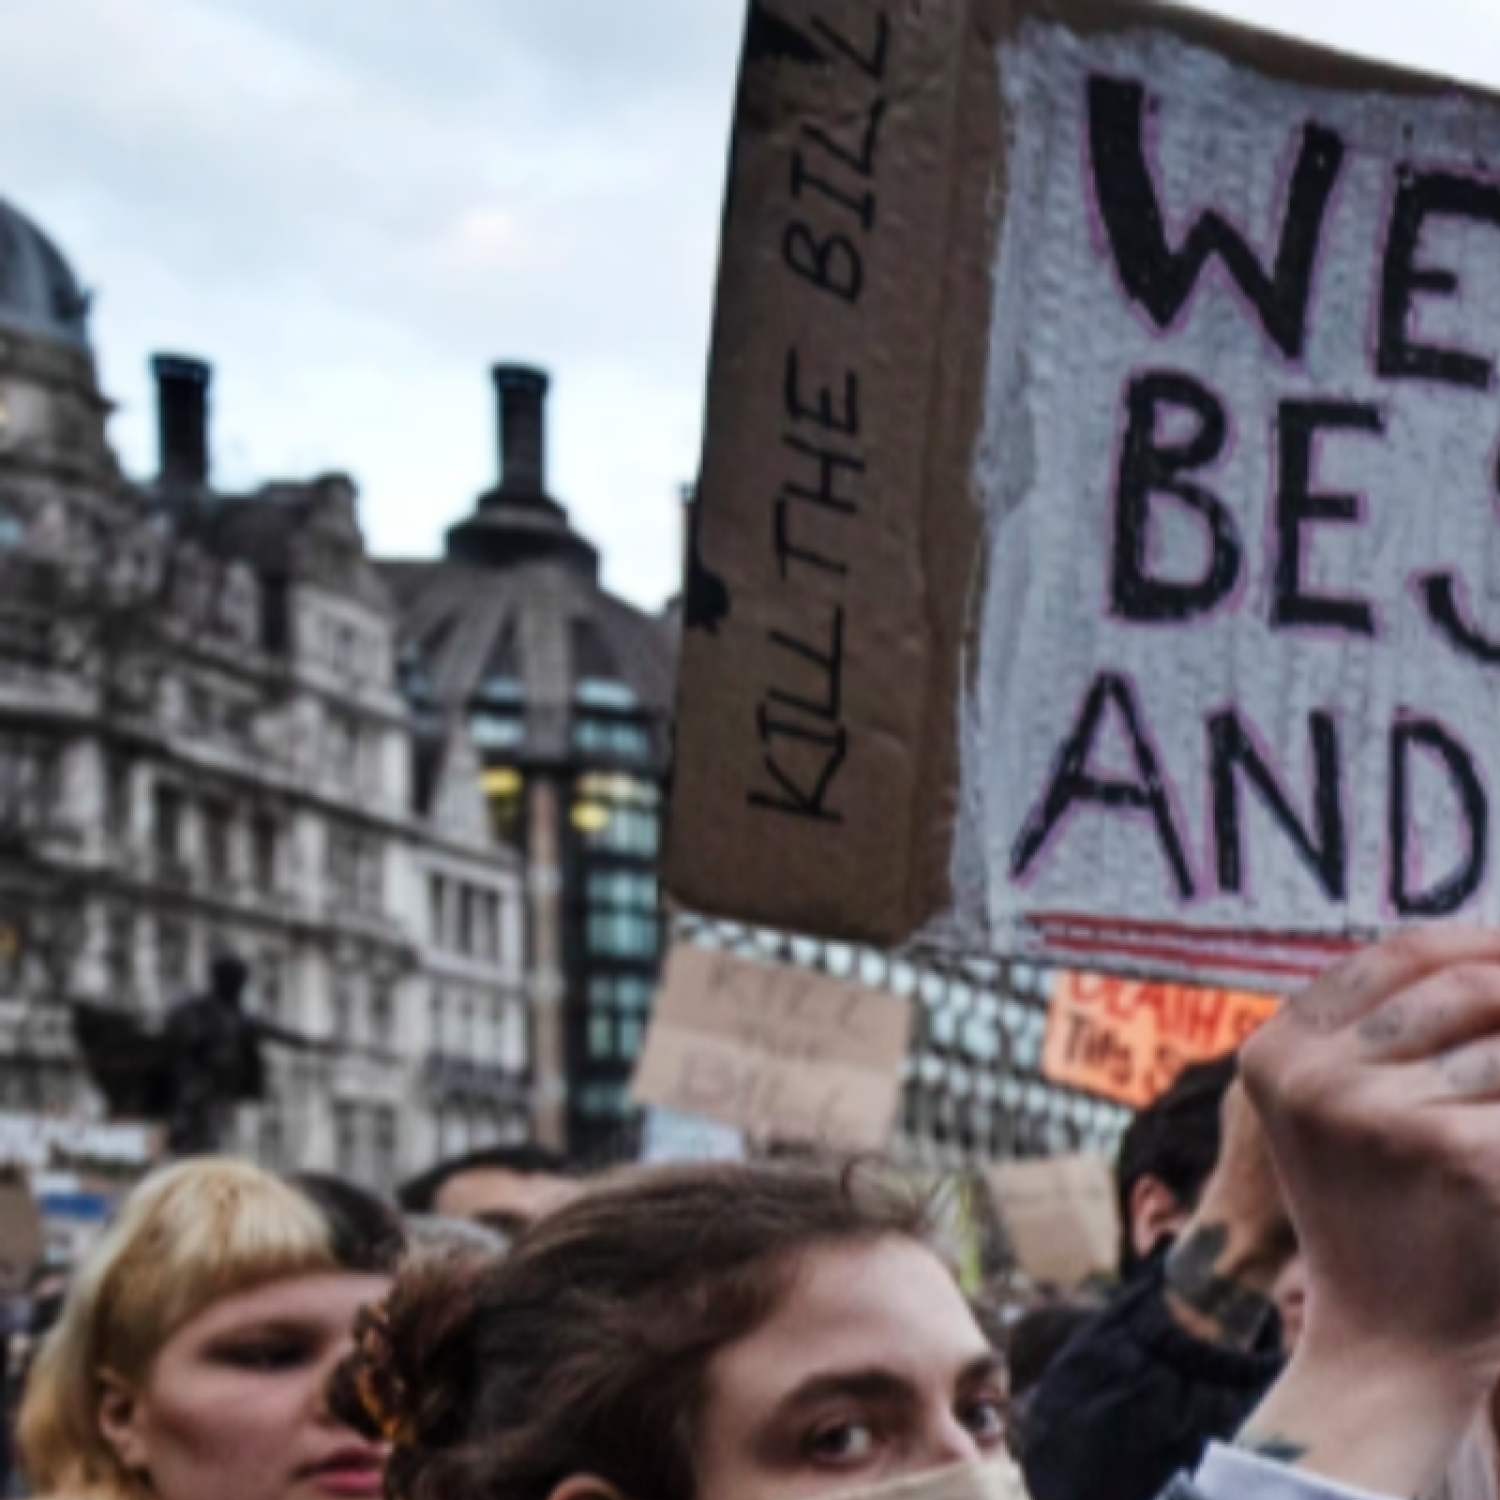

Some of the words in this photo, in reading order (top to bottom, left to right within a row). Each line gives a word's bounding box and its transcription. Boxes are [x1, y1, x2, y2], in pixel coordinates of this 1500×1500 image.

[780, 8, 889, 304] BILL
[774, 347, 865, 581] THE
[1110, 370, 1384, 637] BE
[745, 604, 848, 822] KILL
[1014, 673, 1487, 917] AND
